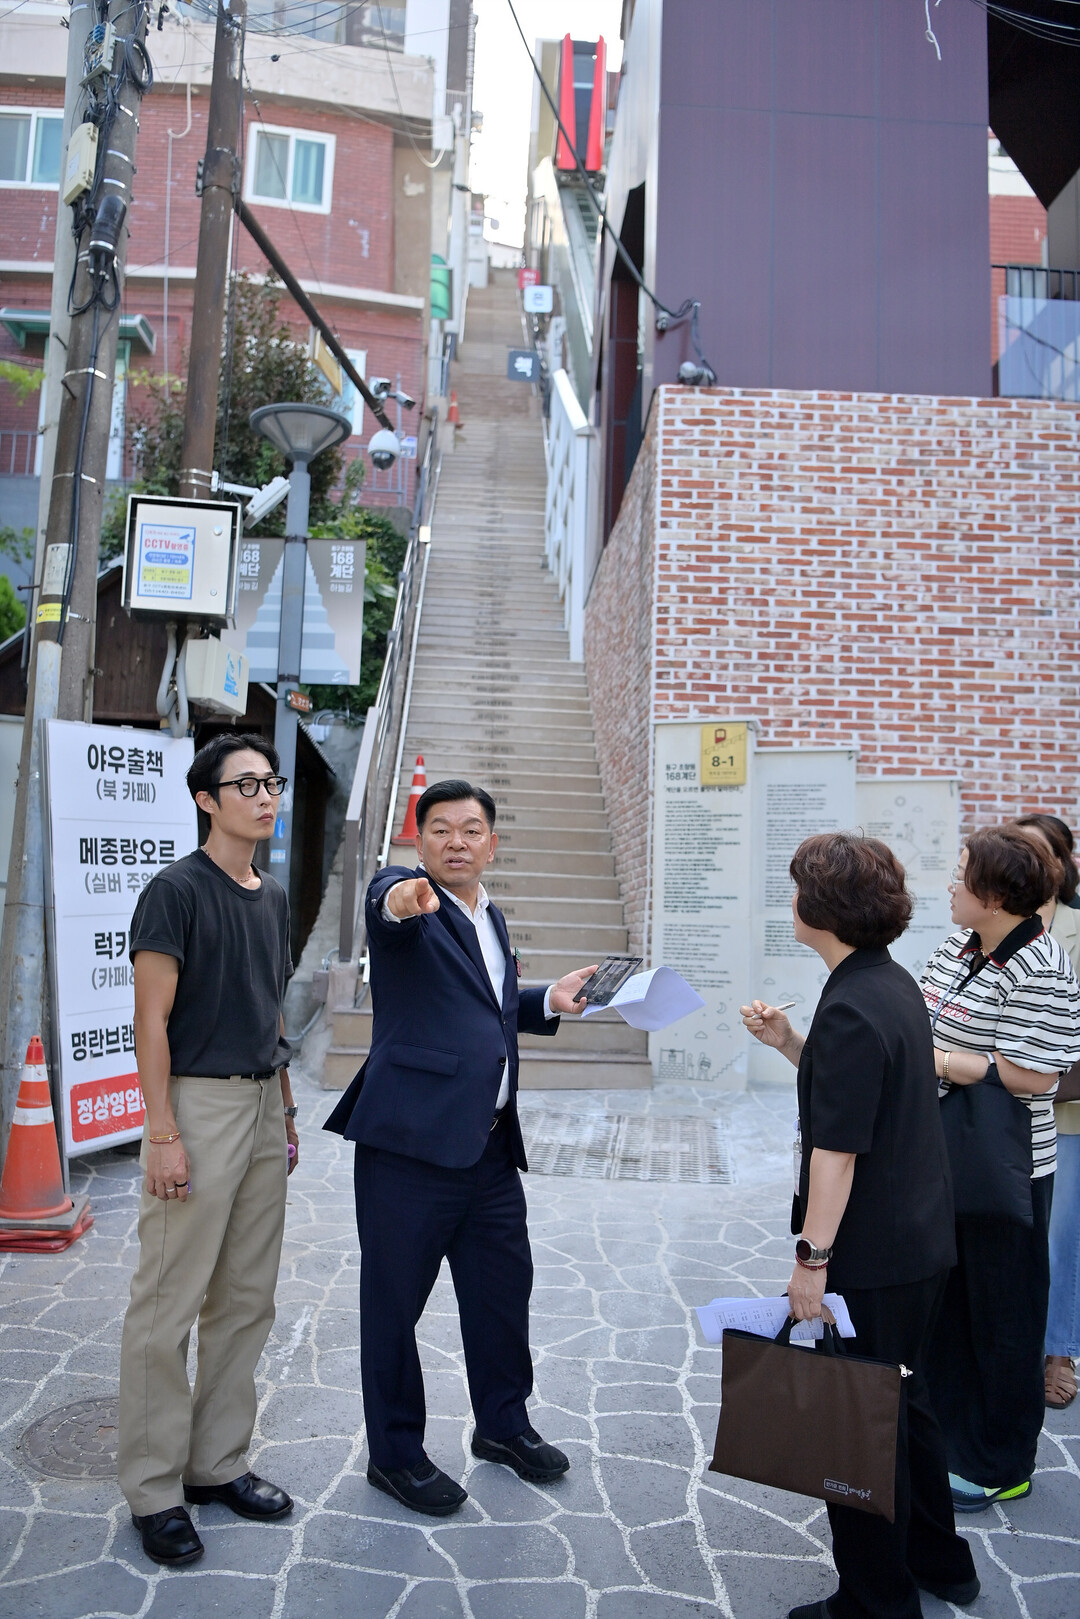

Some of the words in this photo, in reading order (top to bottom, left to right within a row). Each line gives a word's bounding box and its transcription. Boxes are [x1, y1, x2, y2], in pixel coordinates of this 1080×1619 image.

[331, 552, 354, 564] 168
[330, 564, 354, 578] 계단
[87, 743, 163, 778] 야우출책
[712, 756, 734, 767] 8-1
[665, 771, 697, 781] 168계단
[96, 778, 117, 801] (북
[122, 781, 157, 803] 카페)
[79, 837, 176, 866] 메종랑오르
[84, 871, 122, 894] (실버
[77, 1086, 146, 1125] 정상영업
